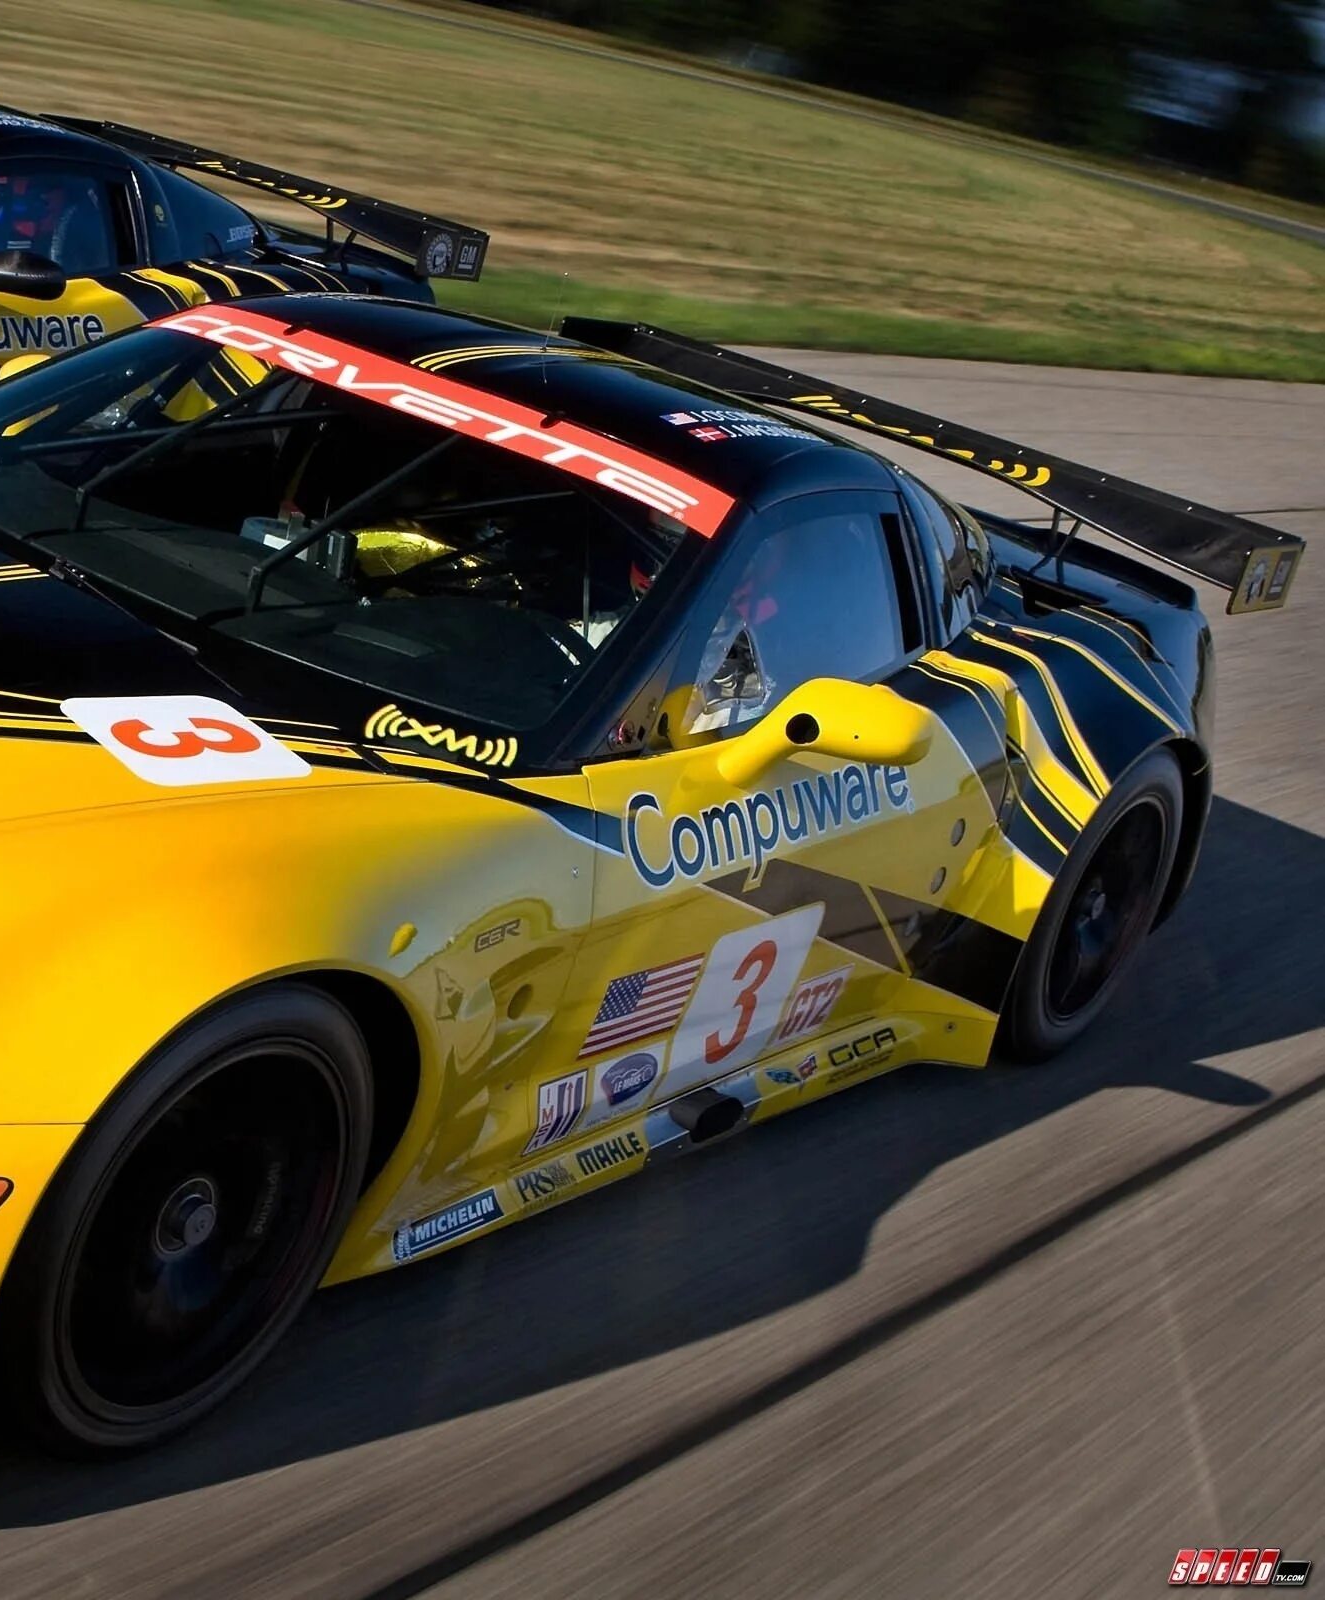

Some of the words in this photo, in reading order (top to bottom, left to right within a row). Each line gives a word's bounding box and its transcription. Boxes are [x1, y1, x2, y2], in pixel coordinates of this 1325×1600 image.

[460, 245, 478, 264] GM
[160, 314, 700, 513] CORVETTE
[110, 717, 262, 759] 3
[626, 763, 911, 889] Compuware
[704, 940, 778, 1065] 3
[778, 977, 844, 1041] GT2
[576, 1131, 644, 1177] MAHLE
[513, 1166, 557, 1204] PRS
[414, 1195, 496, 1242] MICHELIN
